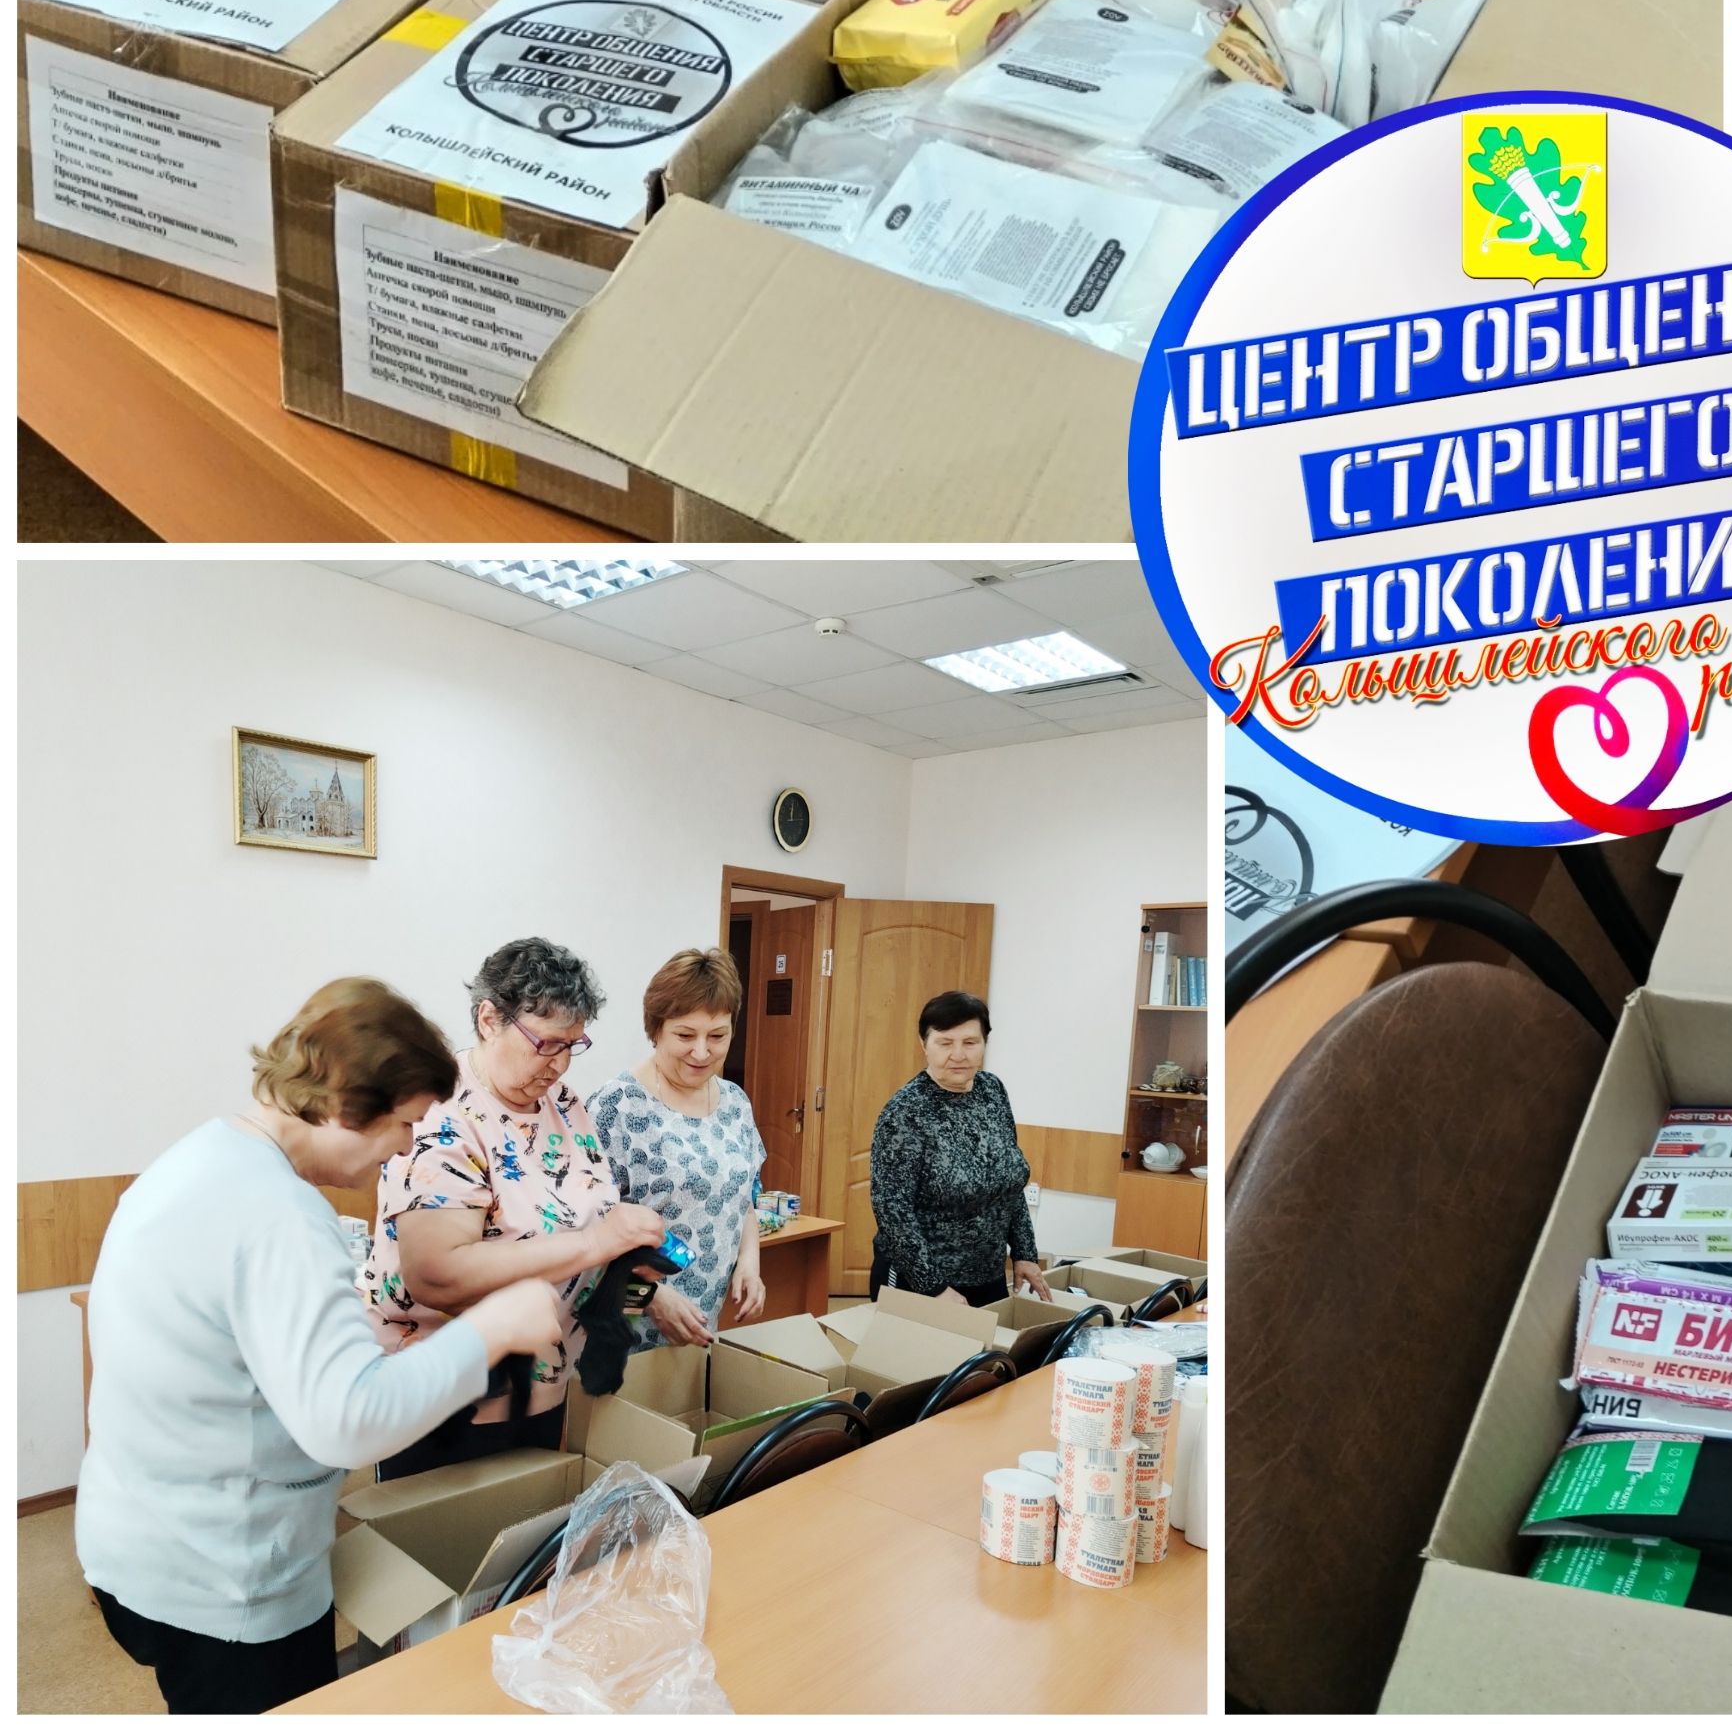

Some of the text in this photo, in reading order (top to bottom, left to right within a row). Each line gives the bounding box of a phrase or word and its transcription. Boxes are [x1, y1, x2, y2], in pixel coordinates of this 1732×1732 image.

[217, 4, 274, 30] РАЙОН
[509, 20, 723, 72] ЦЕНТР ОБЩЕНИЯ
[526, 46, 668, 84] СТАРШЕГО
[504, 66, 662, 109] ПОКОЛЕНИЯ
[385, 123, 612, 201] КОЛЫШЛЕЙСКИЙ РАЙОН
[739, 178, 839, 194] ВИТАМИННЫЙ
[369, 334, 422, 361] Продукты
[1668, 1113, 1717, 1122] MASTER
[1617, 1233, 1700, 1244] Ибупрофен-АКОС
[1066, 1378, 1113, 1392] ТУАЛЕТНАЯ
[1065, 1394, 1112, 1408] МОРДОВСКИЙ
[1072, 1387, 1105, 1400] БУМАГА
[1068, 1402, 1106, 1414] СТАНДАРТ
[1081, 1549, 1125, 1566] ТУАЛЕТНАЯ
[1076, 1564, 1122, 1582] МОРДОВСКИЙ
[1086, 1559, 1117, 1573] БУМАГА
[1080, 1573, 1116, 1587] СТАНДАРТ
